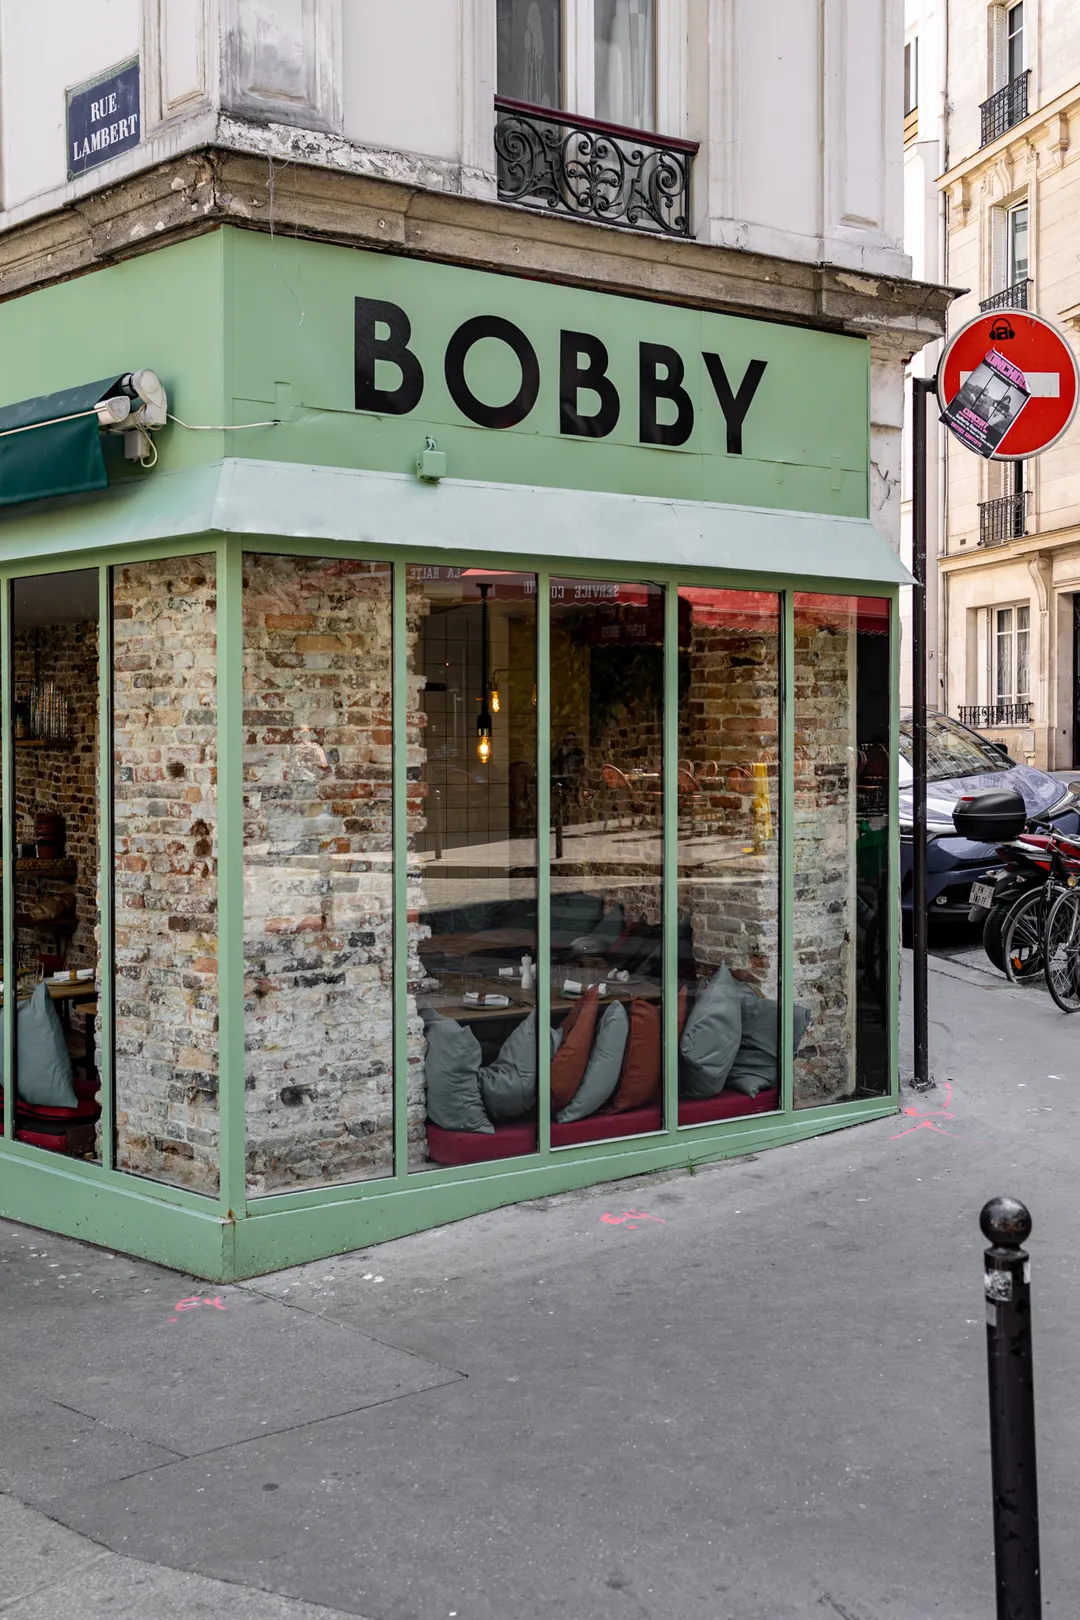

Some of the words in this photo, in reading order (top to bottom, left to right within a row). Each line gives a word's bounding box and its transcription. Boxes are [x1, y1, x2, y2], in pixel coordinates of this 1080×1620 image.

[90, 93, 117, 122] RUE
[73, 113, 138, 161] LAMBERT
[354, 296, 768, 455] BOBBY
